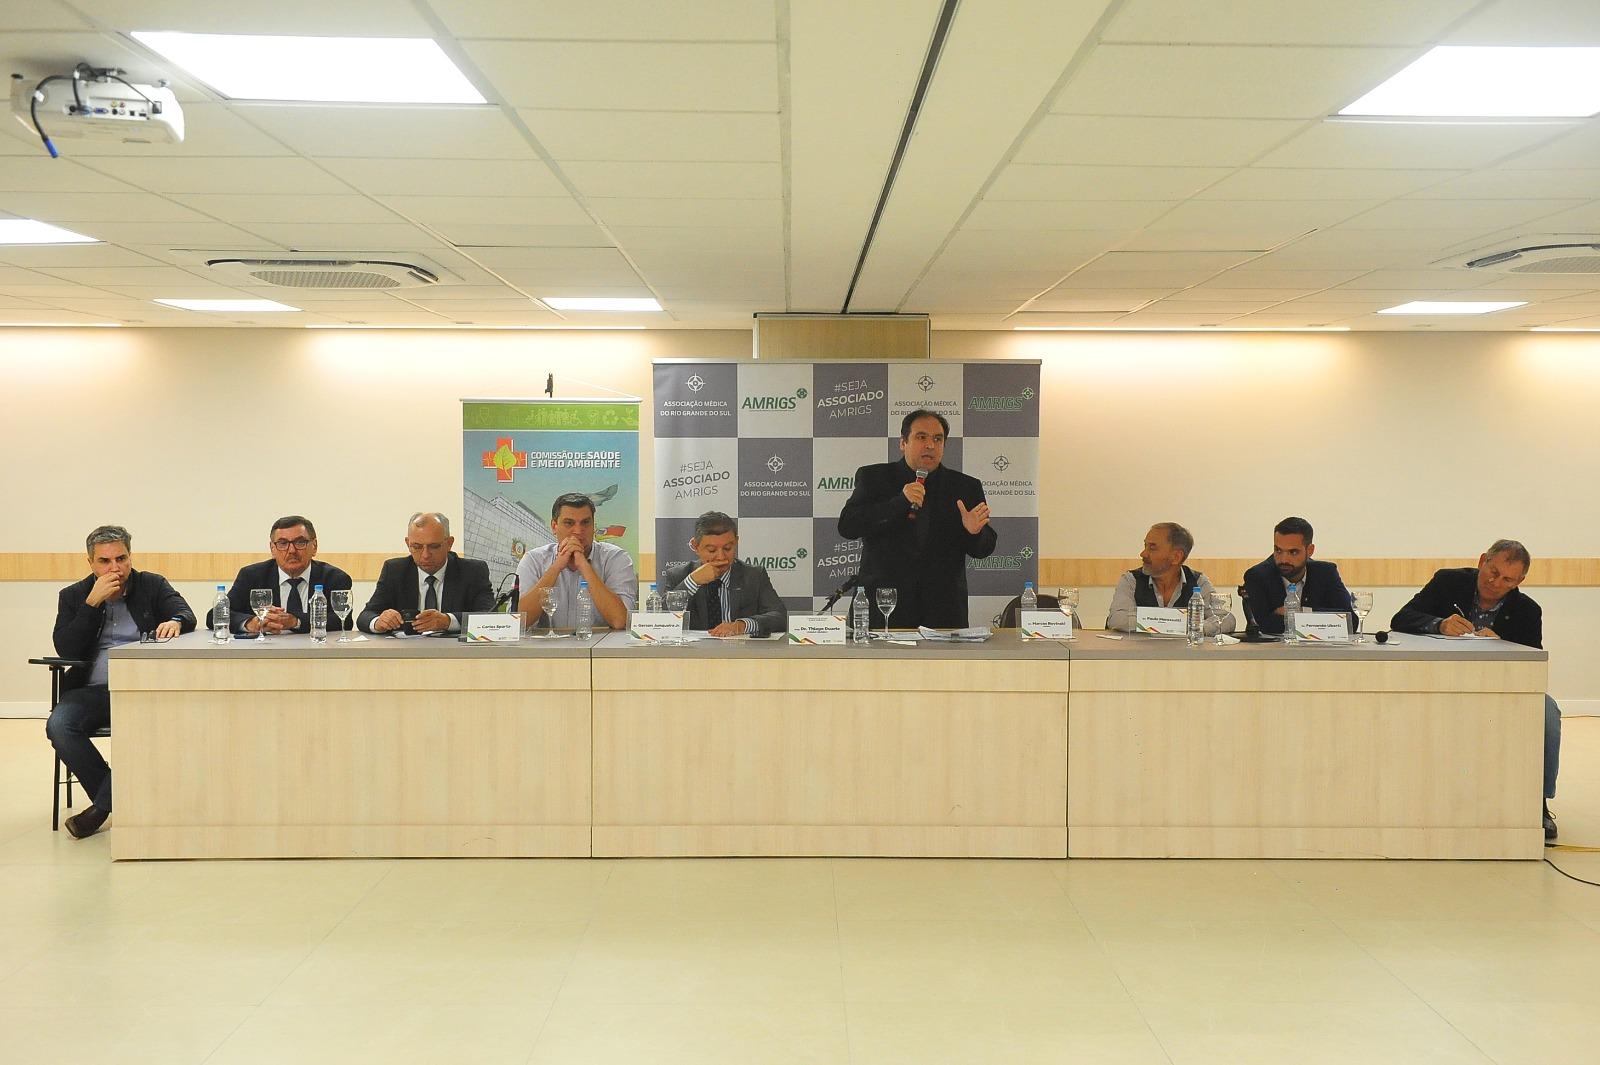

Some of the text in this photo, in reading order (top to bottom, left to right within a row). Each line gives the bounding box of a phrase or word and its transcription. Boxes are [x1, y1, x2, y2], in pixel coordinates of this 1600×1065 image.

[834, 380, 868, 392] #SEJA
[664, 400, 703, 408] ASSOCIAÇÃO
[742, 397, 796, 409] AMRIGS
[818, 390, 884, 408] ASSOCIADO
[895, 400, 932, 408] ASSOCIAÇÃO
[968, 396, 1024, 410] AMRIGS
[830, 404, 872, 419] AMRIGS
[531, 450, 620, 460] COMISSÃO DE SAÚDE
[530, 460, 620, 468] E MEIO AMBIENTE
[680, 460, 714, 473] #SEJA
[663, 471, 730, 488] ASSOCIADO
[744, 480, 783, 488] ASSOCIAÇÃO
[675, 486, 718, 500] AMRIGS
[967, 556, 1022, 568] AMRIGS
